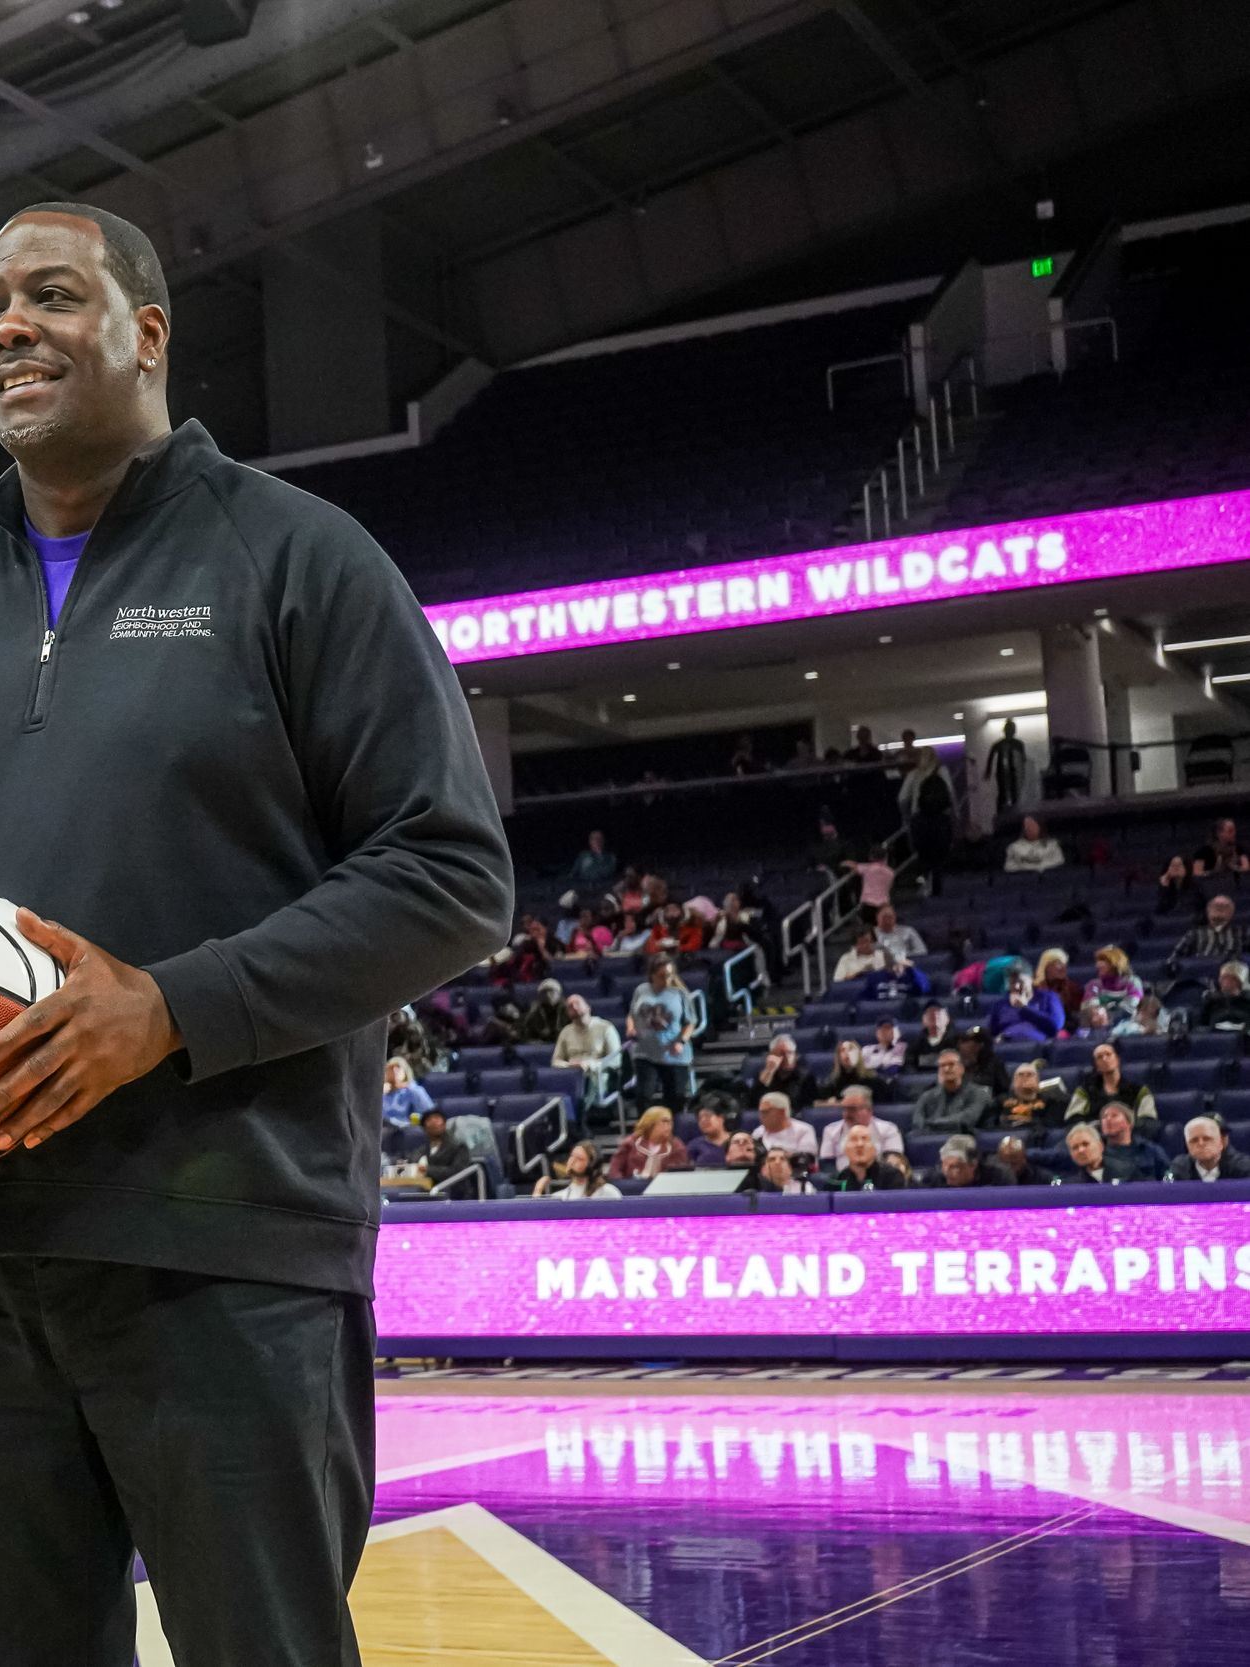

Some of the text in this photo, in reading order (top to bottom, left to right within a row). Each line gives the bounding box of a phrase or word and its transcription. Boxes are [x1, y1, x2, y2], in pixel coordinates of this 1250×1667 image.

[807, 533, 1067, 602] WILDCATS
[110, 630, 159, 640] COMMUNITY
[111, 621, 202, 632] NEIGHBORHOOD AND
[536, 1253, 866, 1300] MARYLAND
